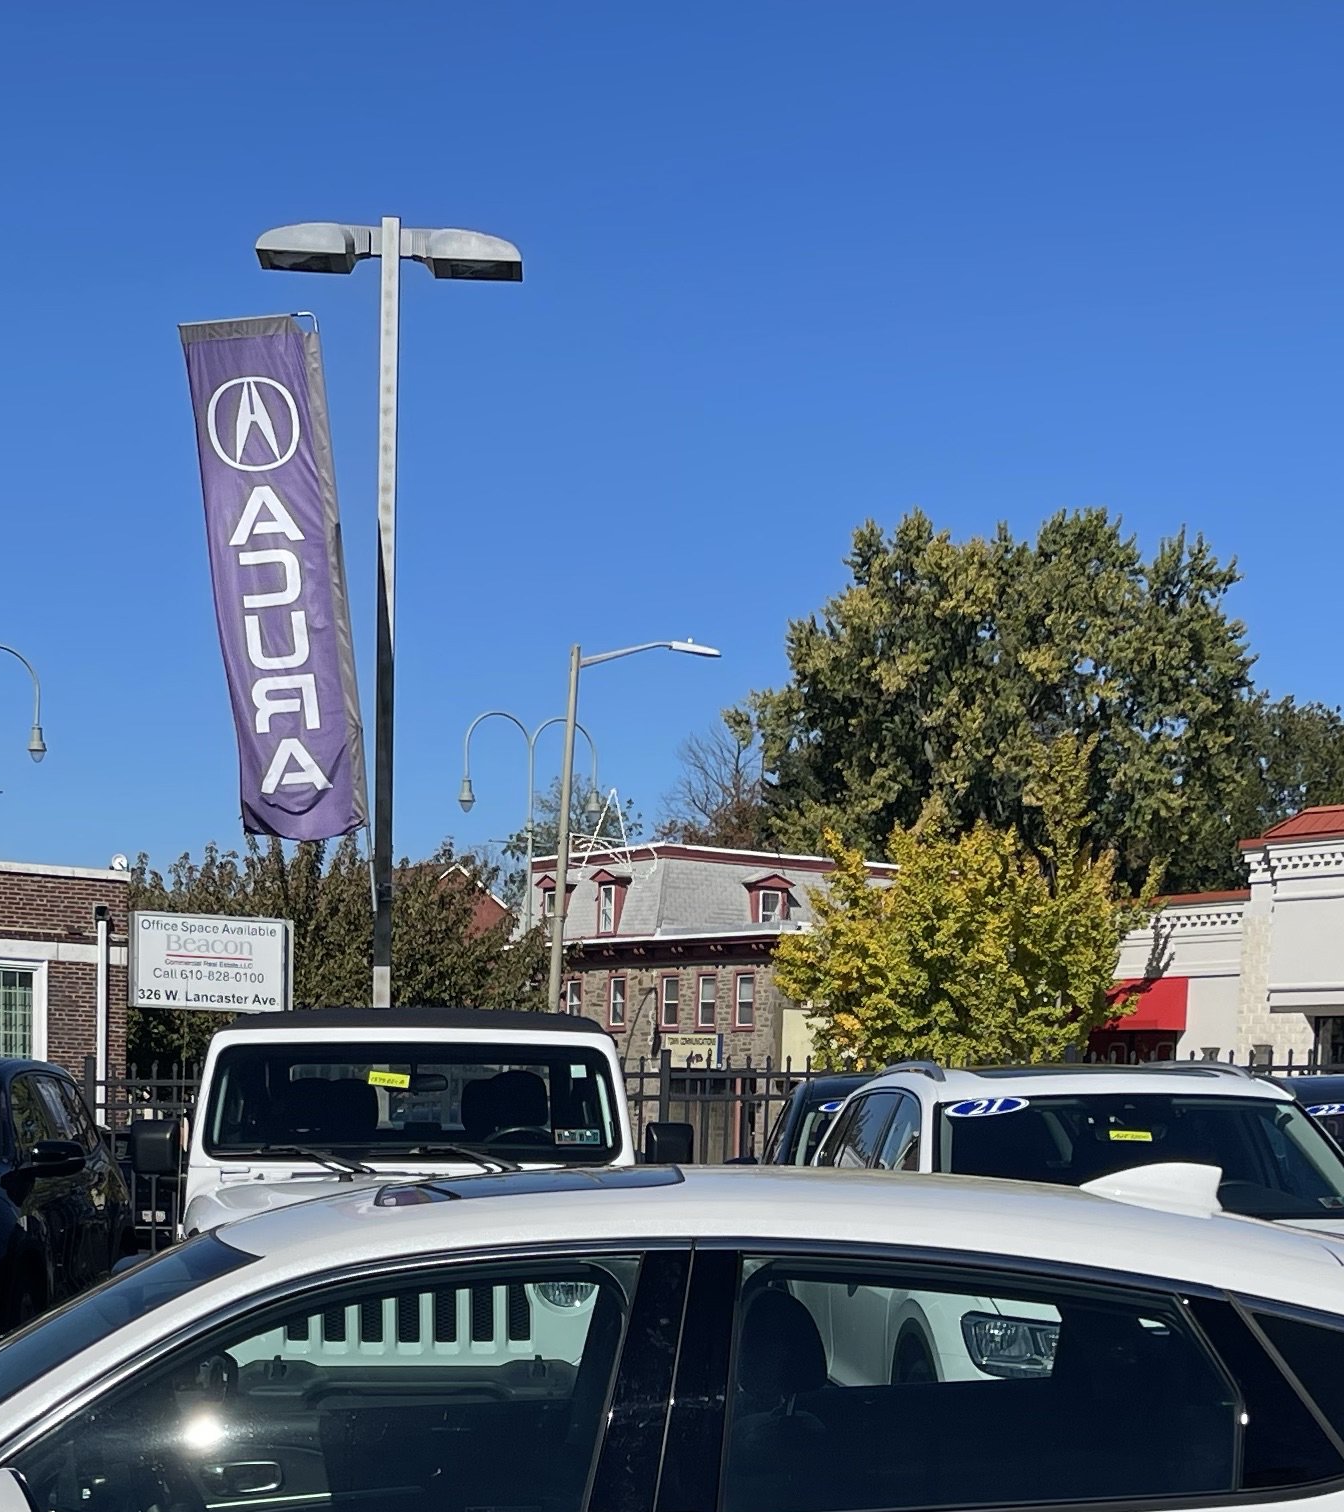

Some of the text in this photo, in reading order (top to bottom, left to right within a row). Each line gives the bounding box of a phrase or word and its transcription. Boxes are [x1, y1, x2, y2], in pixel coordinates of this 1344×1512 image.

[141, 918, 277, 937] Office Space Available
[165, 932, 253, 956] Beacon
[153, 967, 264, 984] Call 610-828-0100
[138, 988, 161, 1001] 326
[185, 990, 248, 1005] Lancaster
[252, 992, 280, 1007] Ave.
[968, 1098, 1002, 1116] 21
